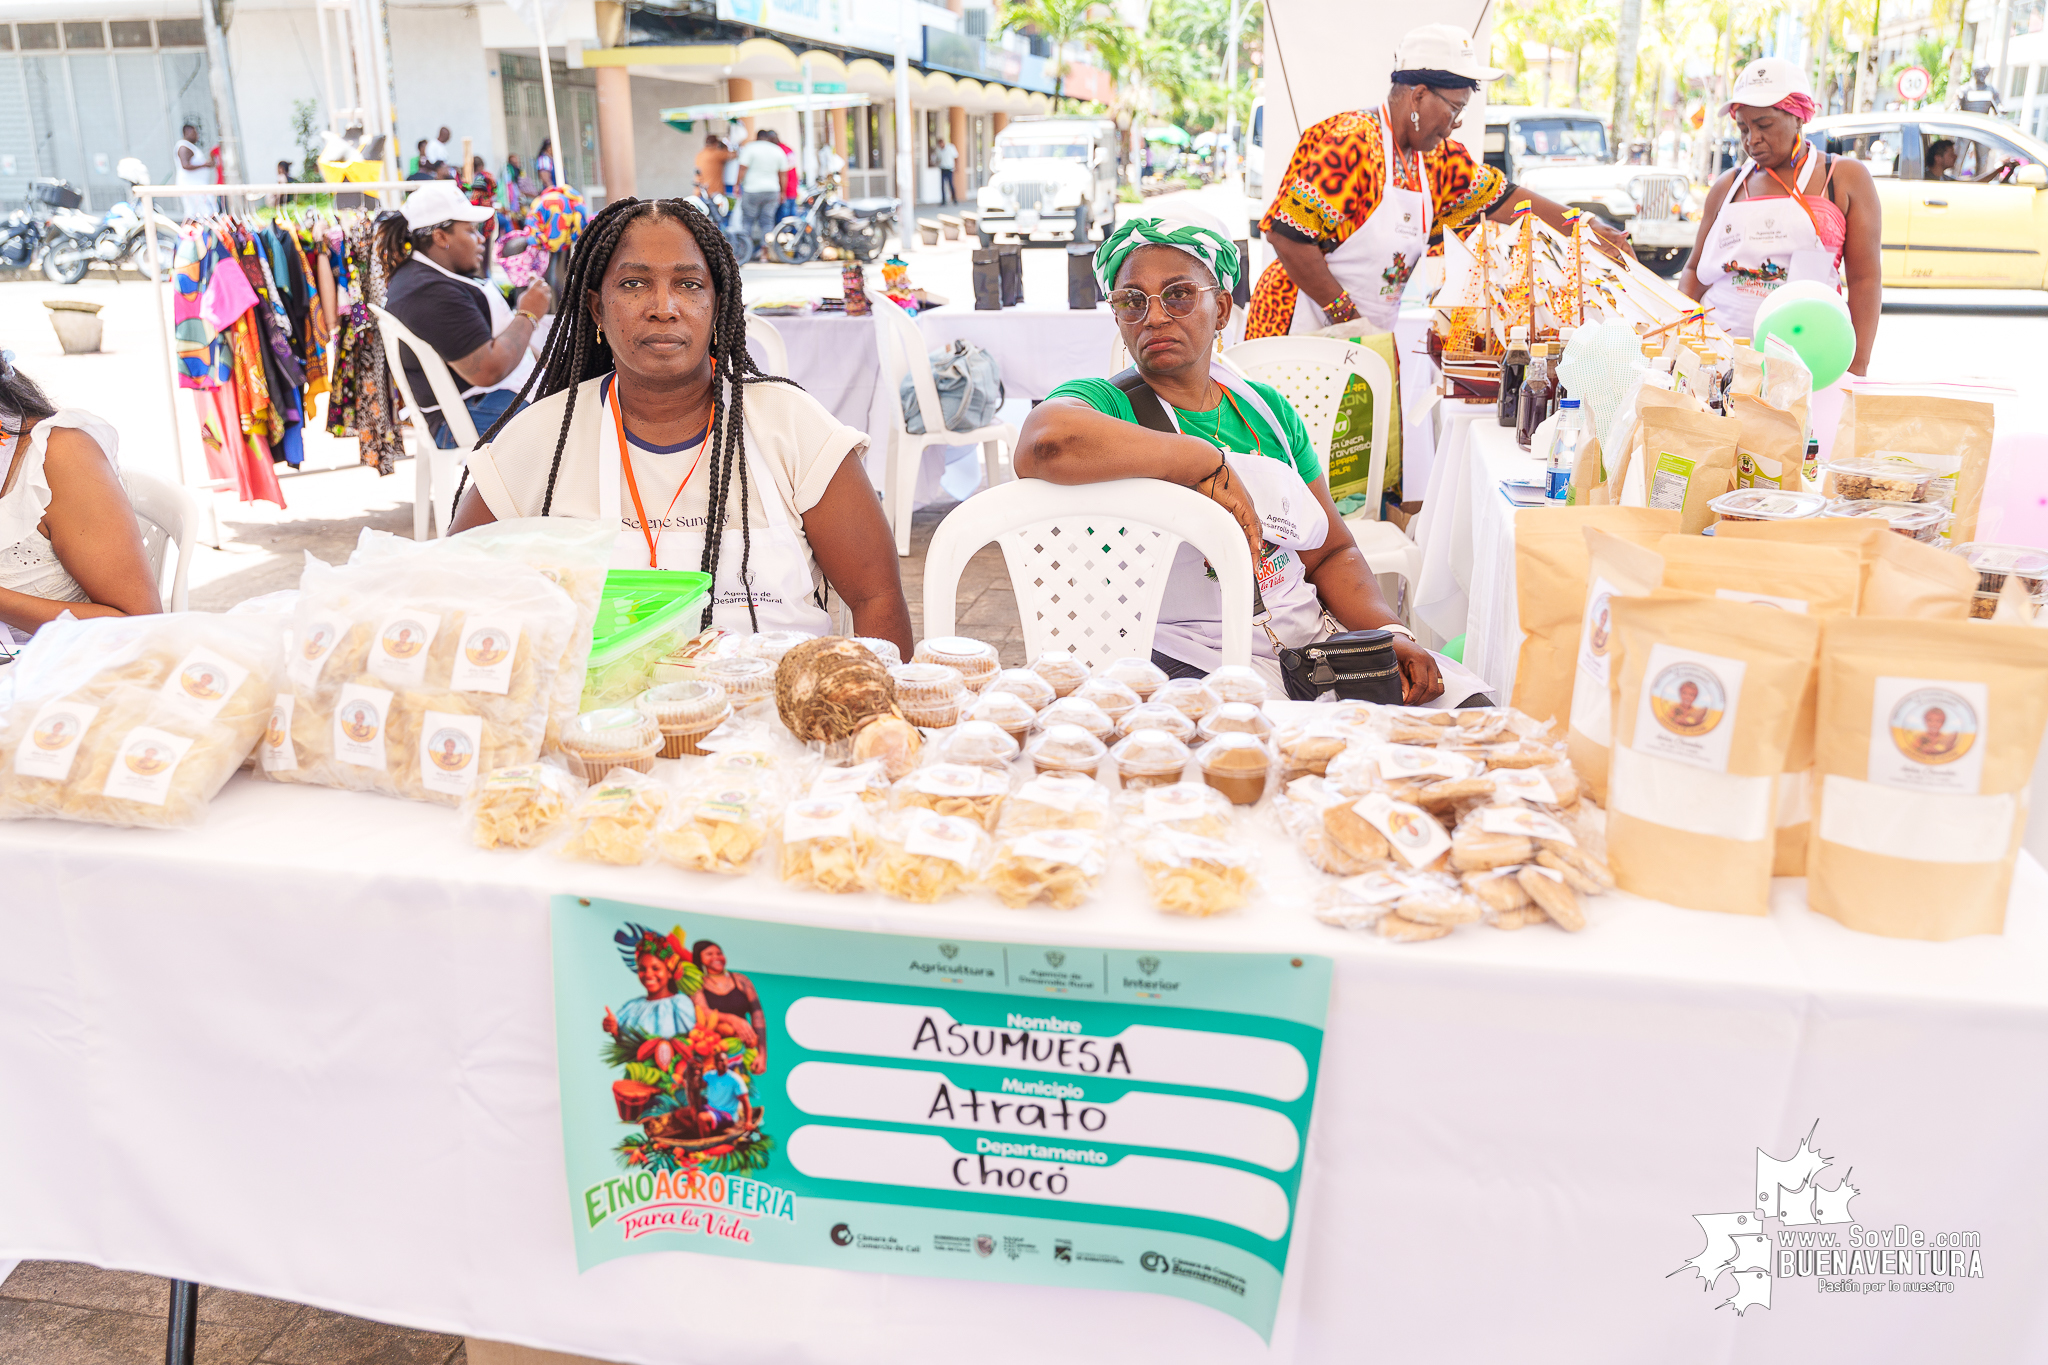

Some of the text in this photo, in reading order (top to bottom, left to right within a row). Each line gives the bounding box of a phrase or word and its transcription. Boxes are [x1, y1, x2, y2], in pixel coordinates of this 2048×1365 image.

[1335, 440, 1371, 458] DIVERSIÓ
[621, 514, 731, 529] Seene Suny
[1257, 551, 1291, 581] GROFERIA
[713, 597, 758, 605] Desarroo
[909, 959, 995, 978] Agricultura
[1123, 976, 1181, 992] Interior
[1007, 1013, 1082, 1034] Nombre
[912, 1016, 1132, 1075] ASUMUESA
[1001, 1077, 1084, 1100] Municipio
[928, 1082, 1107, 1132] Atrato
[976, 1137, 1108, 1165] Departamento
[583, 1170, 797, 1231] ETNOAGROFERIA
[623, 1208, 754, 1245] para la Vida
